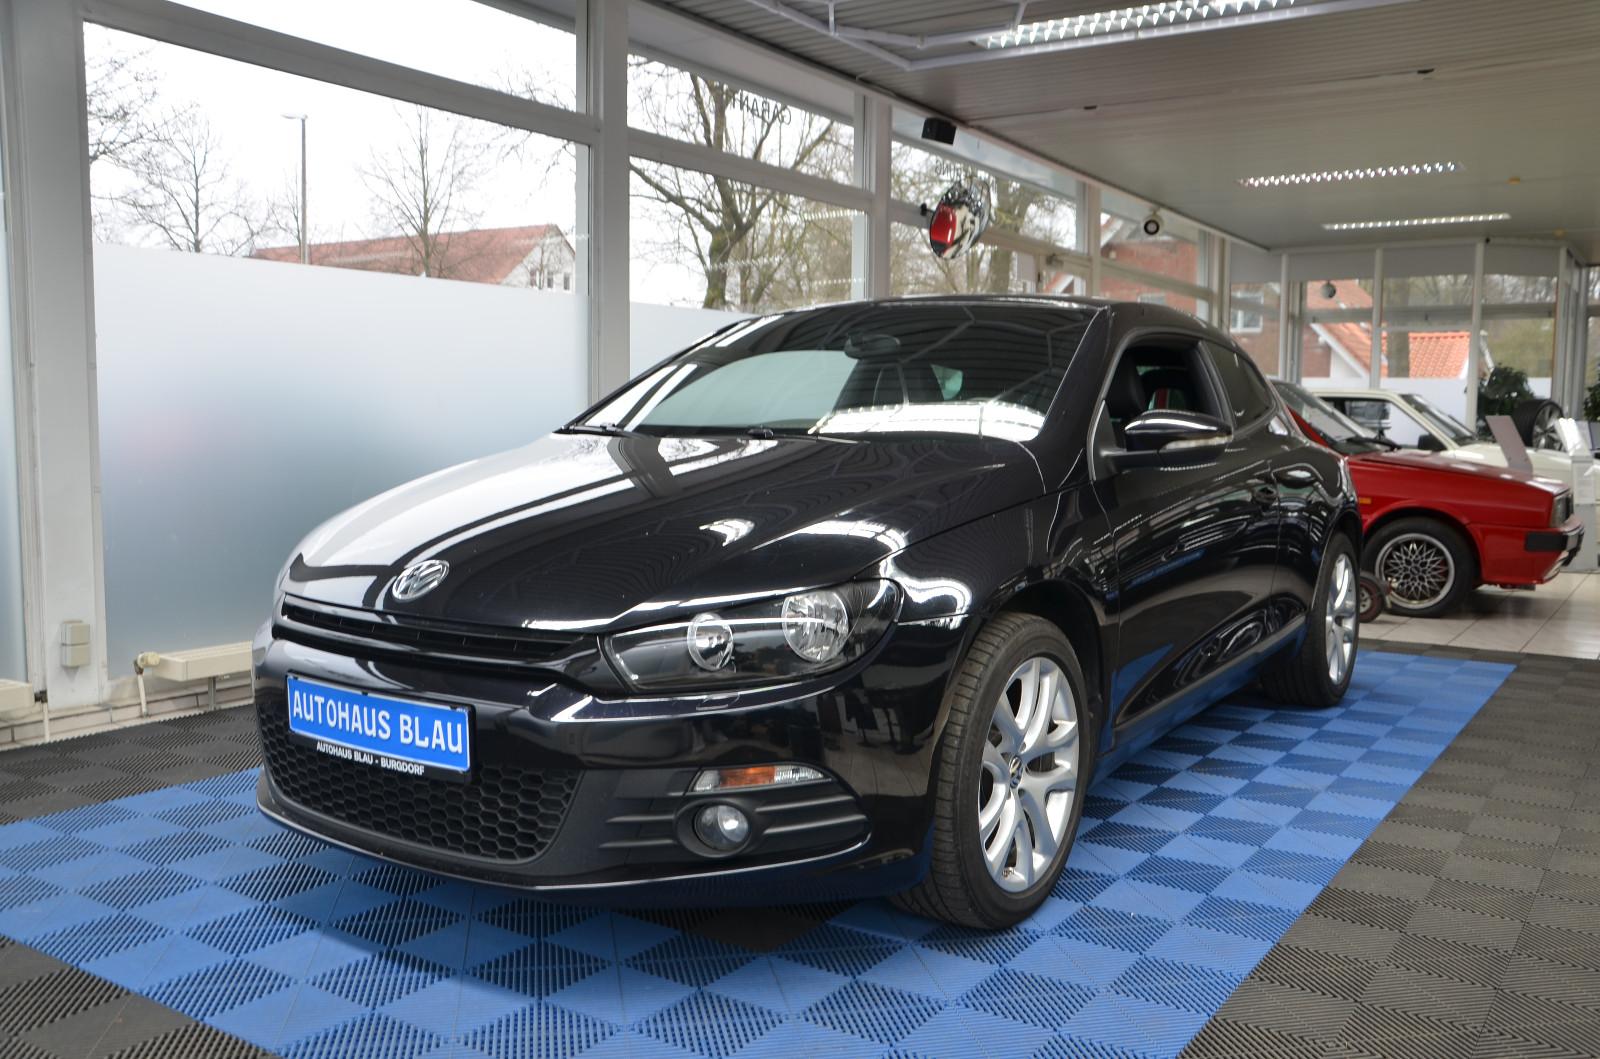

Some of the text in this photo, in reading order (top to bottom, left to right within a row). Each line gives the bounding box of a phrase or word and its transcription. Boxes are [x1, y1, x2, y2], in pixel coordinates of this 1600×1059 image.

[293, 690, 463, 754] AUTOHAUS BLAU
[316, 741, 352, 760] AUTOHAUS
[353, 750, 373, 765] BLAU
[381, 757, 425, 776] BURGDORF
